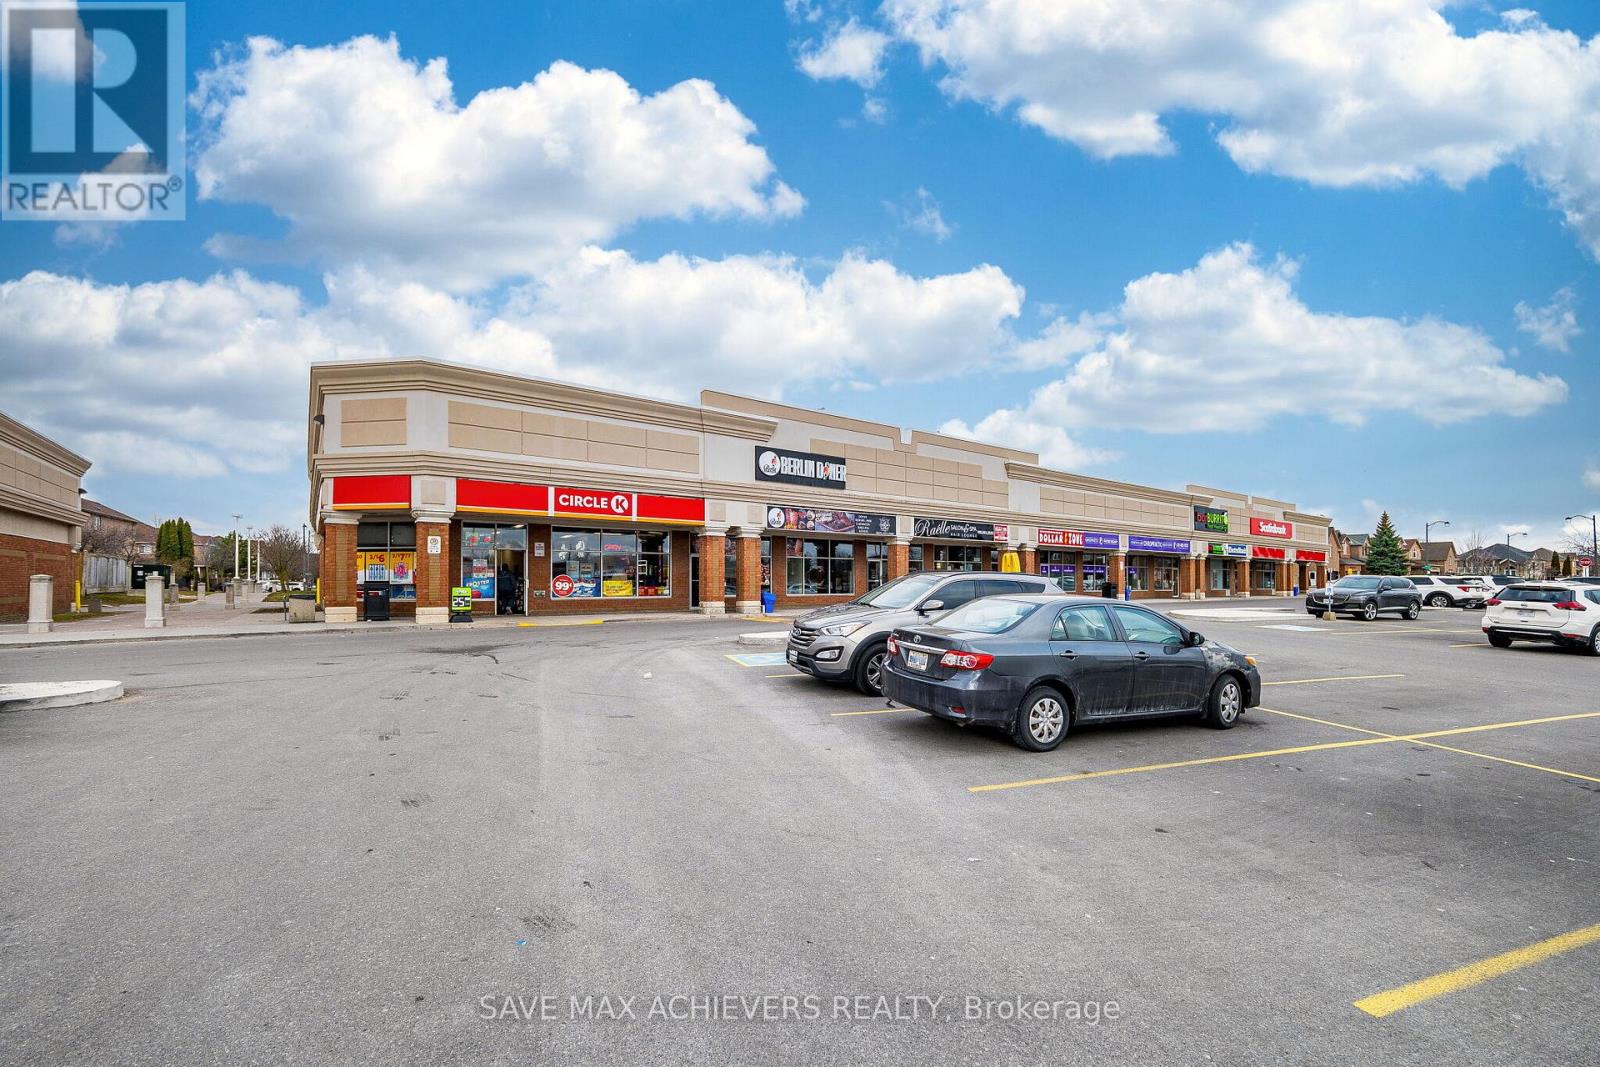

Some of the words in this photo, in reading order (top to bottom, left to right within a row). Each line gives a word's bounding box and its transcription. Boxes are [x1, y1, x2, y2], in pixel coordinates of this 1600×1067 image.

[780, 456, 816, 478] BERLIN
[558, 494, 608, 509] CIRCLE
[611, 495, 629, 513] K
[1039, 533, 1064, 544] DOLLAR
